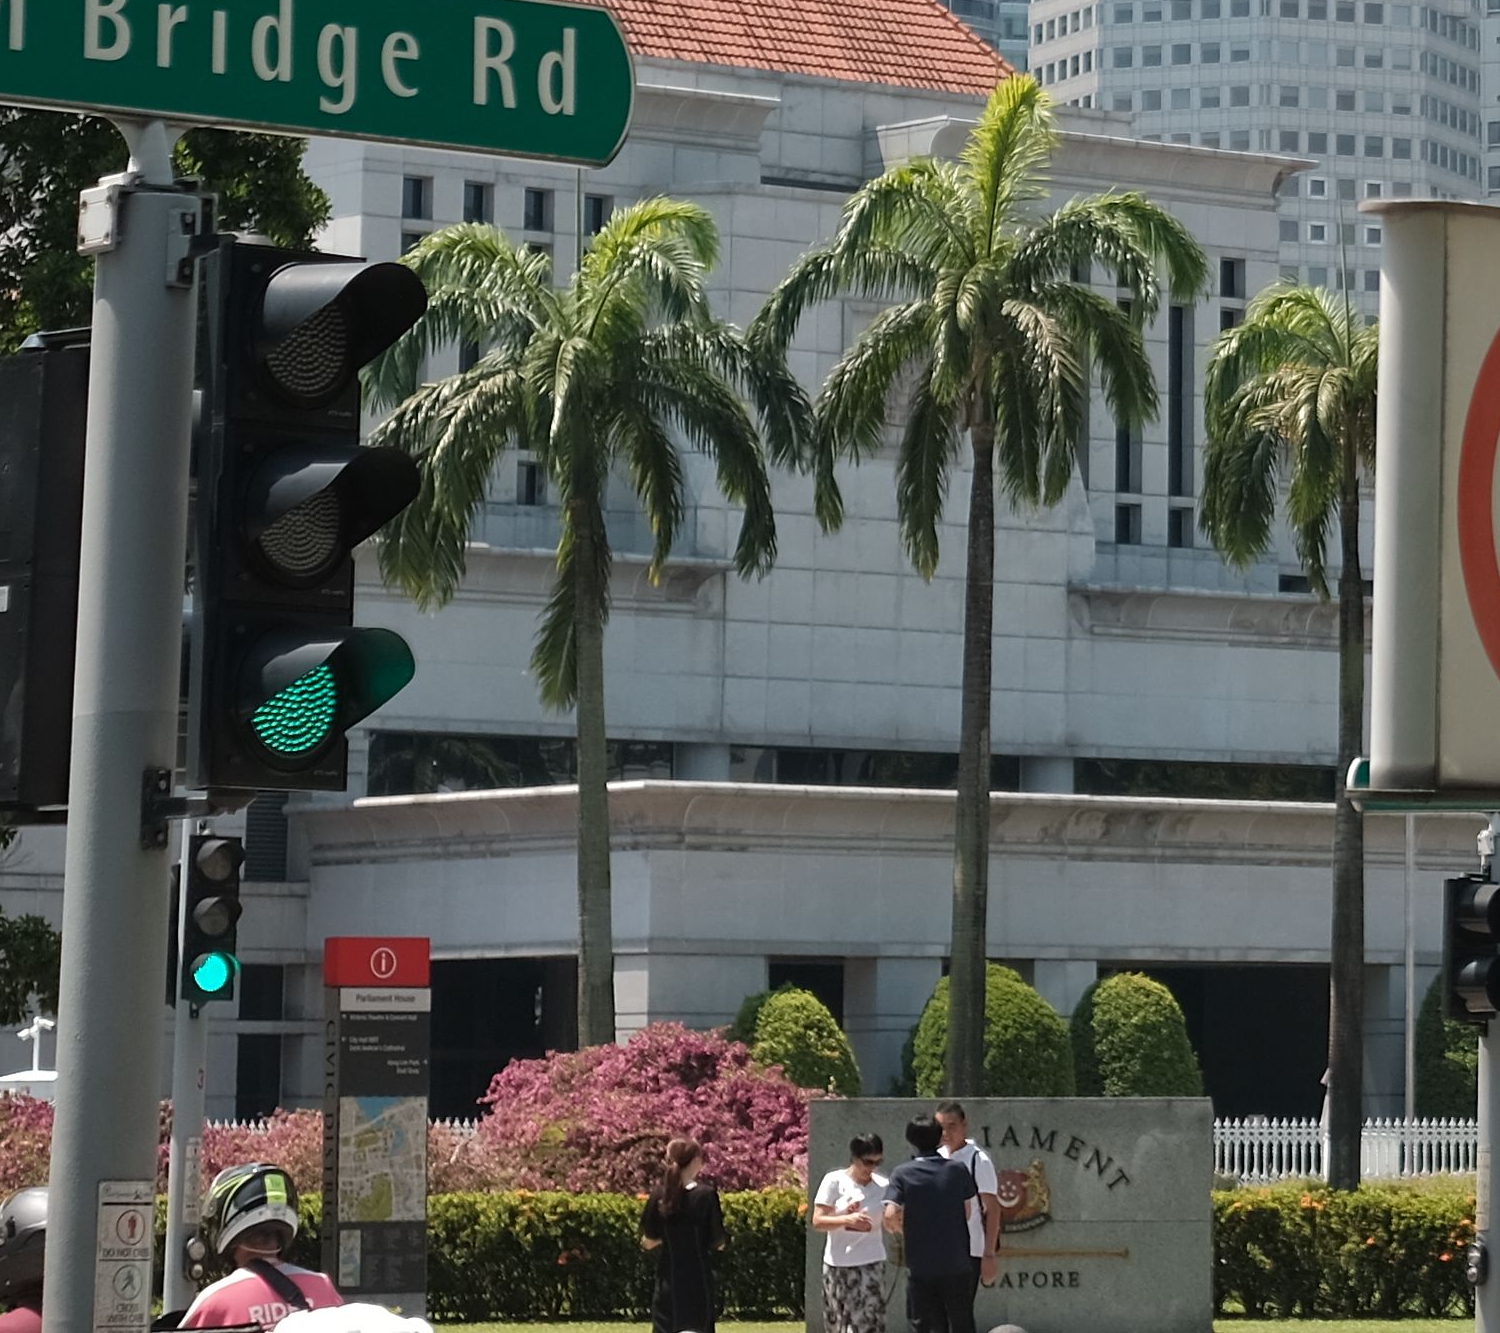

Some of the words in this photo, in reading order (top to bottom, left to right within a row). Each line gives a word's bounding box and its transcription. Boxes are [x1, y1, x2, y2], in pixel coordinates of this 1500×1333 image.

[473, 15, 577, 117] Rd
[325, 1020, 335, 1098] CIVIC
[323, 1113, 335, 1241] DISTRICT
[981, 1125, 1131, 1192] IAMENT
[981, 1271, 1081, 1289] APORE
